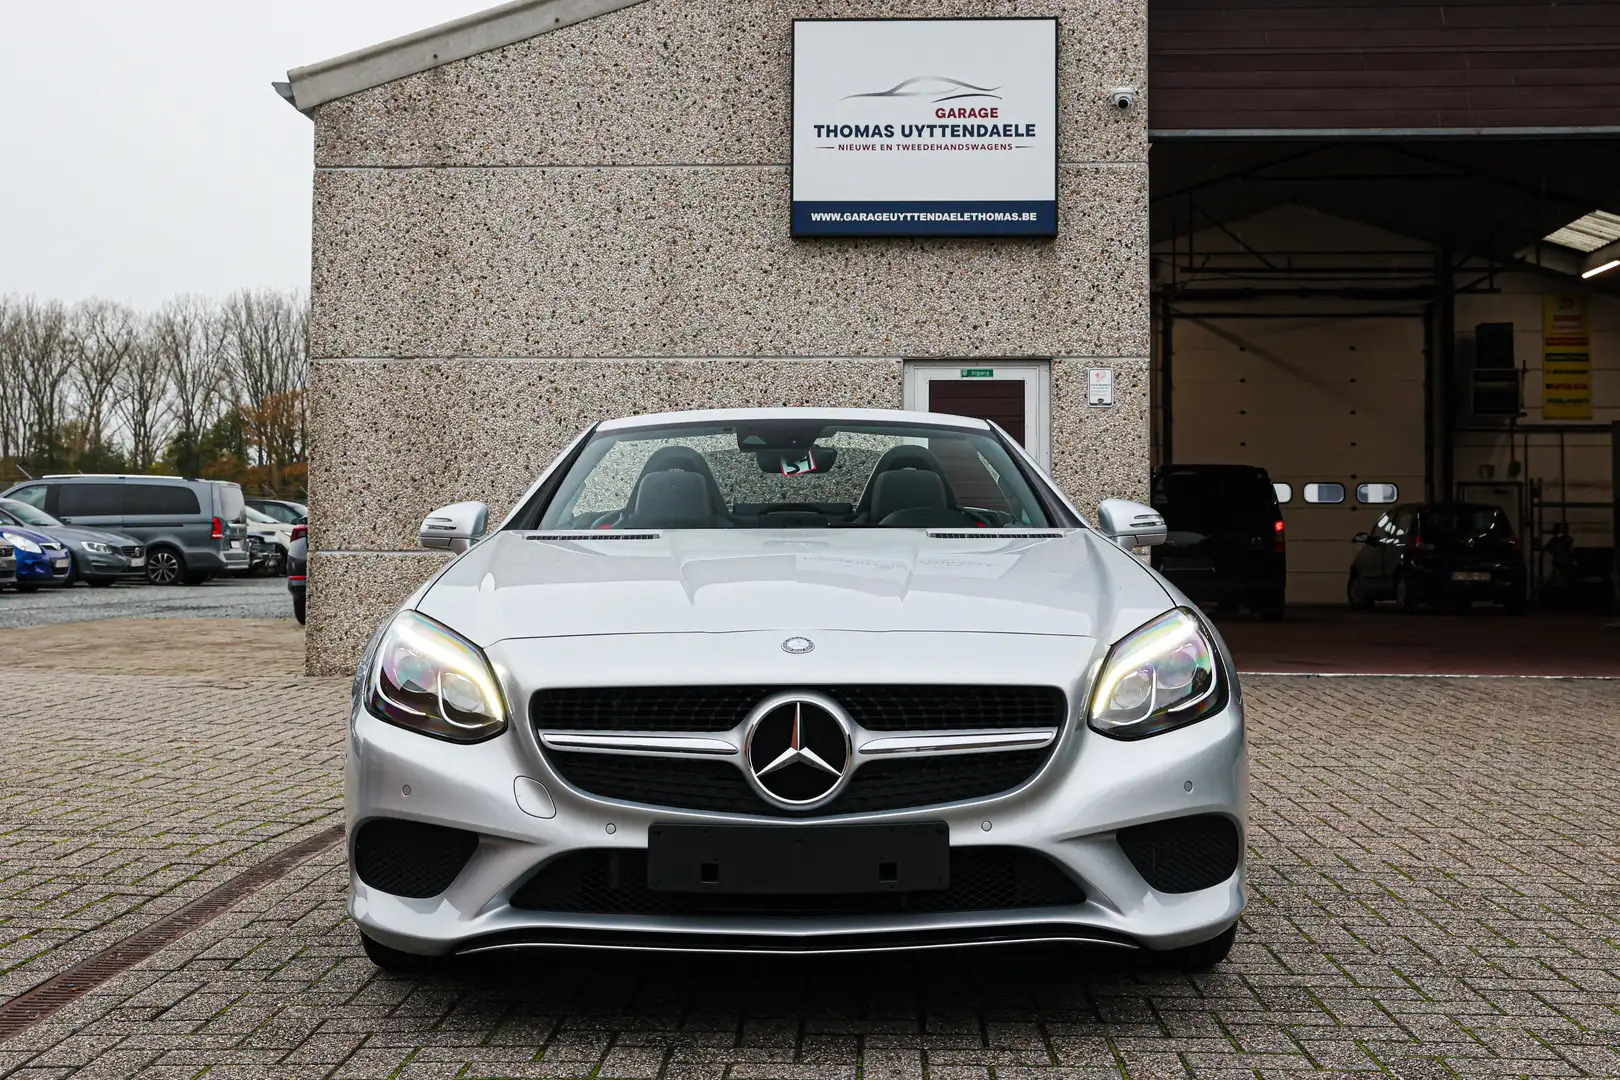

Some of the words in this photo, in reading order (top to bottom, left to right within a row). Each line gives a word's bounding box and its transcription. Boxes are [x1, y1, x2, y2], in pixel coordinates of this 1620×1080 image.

[934, 107, 999, 119] GARAGE
[813, 124, 895, 138] THOMAS
[901, 123, 1036, 138] UYTTENDAELE
[838, 143, 877, 151] NIEUWE
[880, 143, 893, 151] EN
[896, 143, 1013, 151] TWEEDEHANDSWAGENS
[811, 212, 1037, 222] WWW.GARAGEUYTTENDAELETHOMAS.BE
